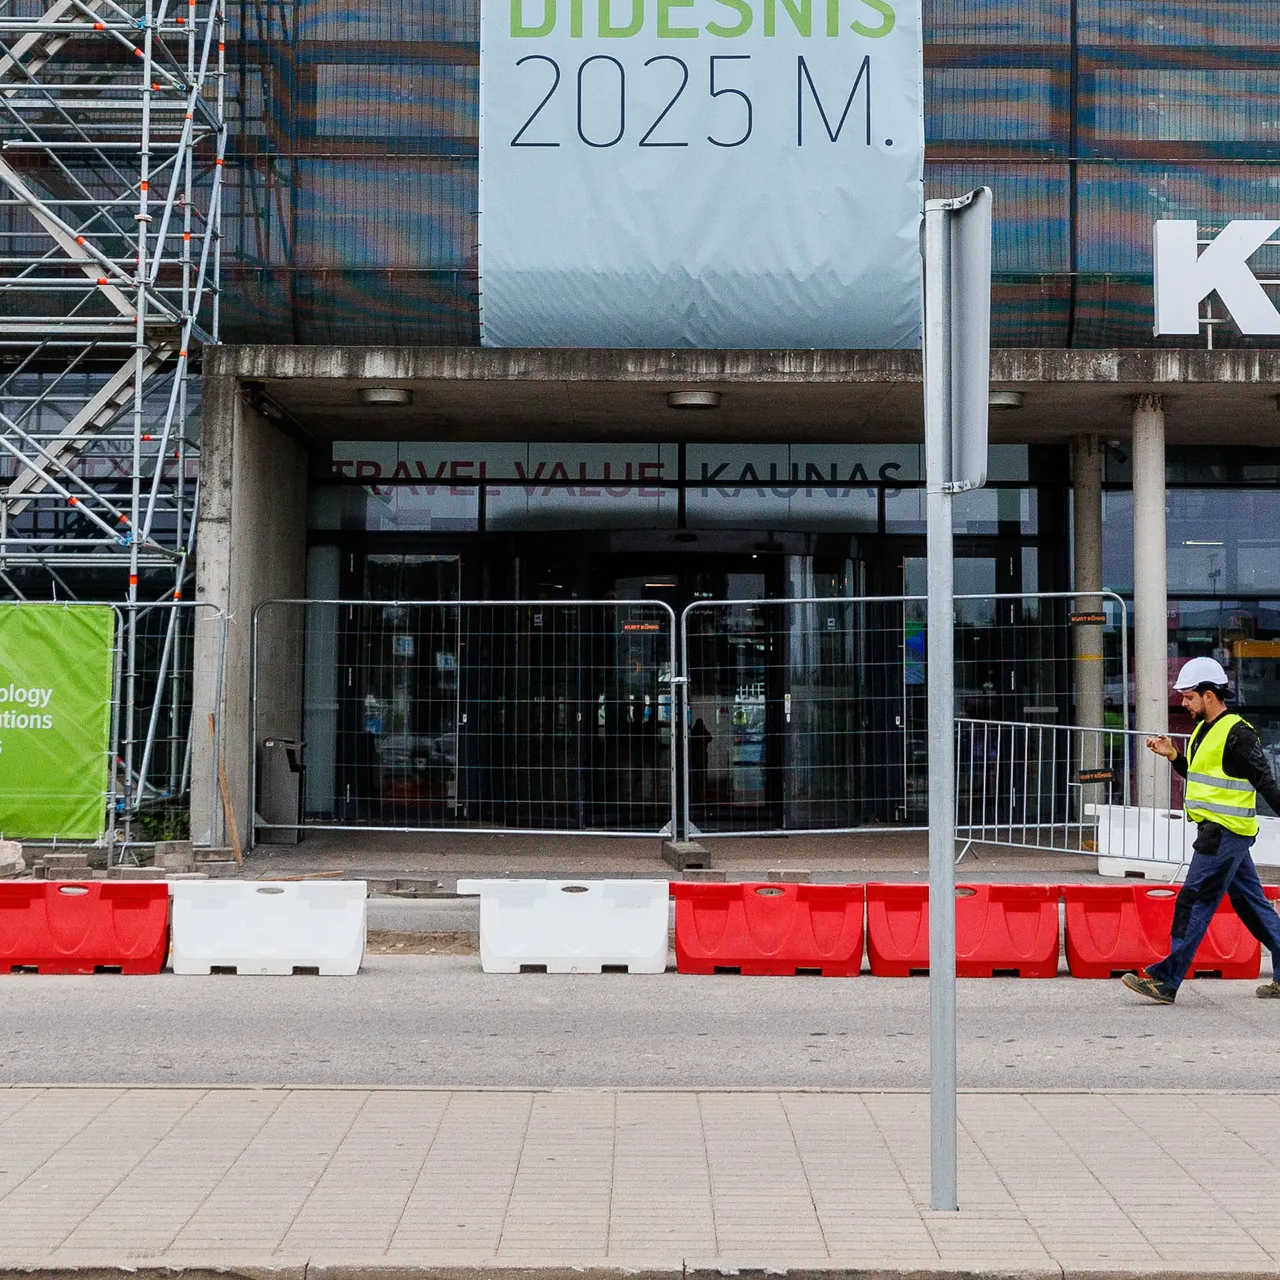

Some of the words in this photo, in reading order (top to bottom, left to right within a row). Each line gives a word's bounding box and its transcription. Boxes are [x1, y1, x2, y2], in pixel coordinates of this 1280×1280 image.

[511, 55, 753, 147] 2025
[797, 55, 893, 147] M.
[515, 461, 665, 499] VALUE
[701, 462, 903, 500] KAUNAS
